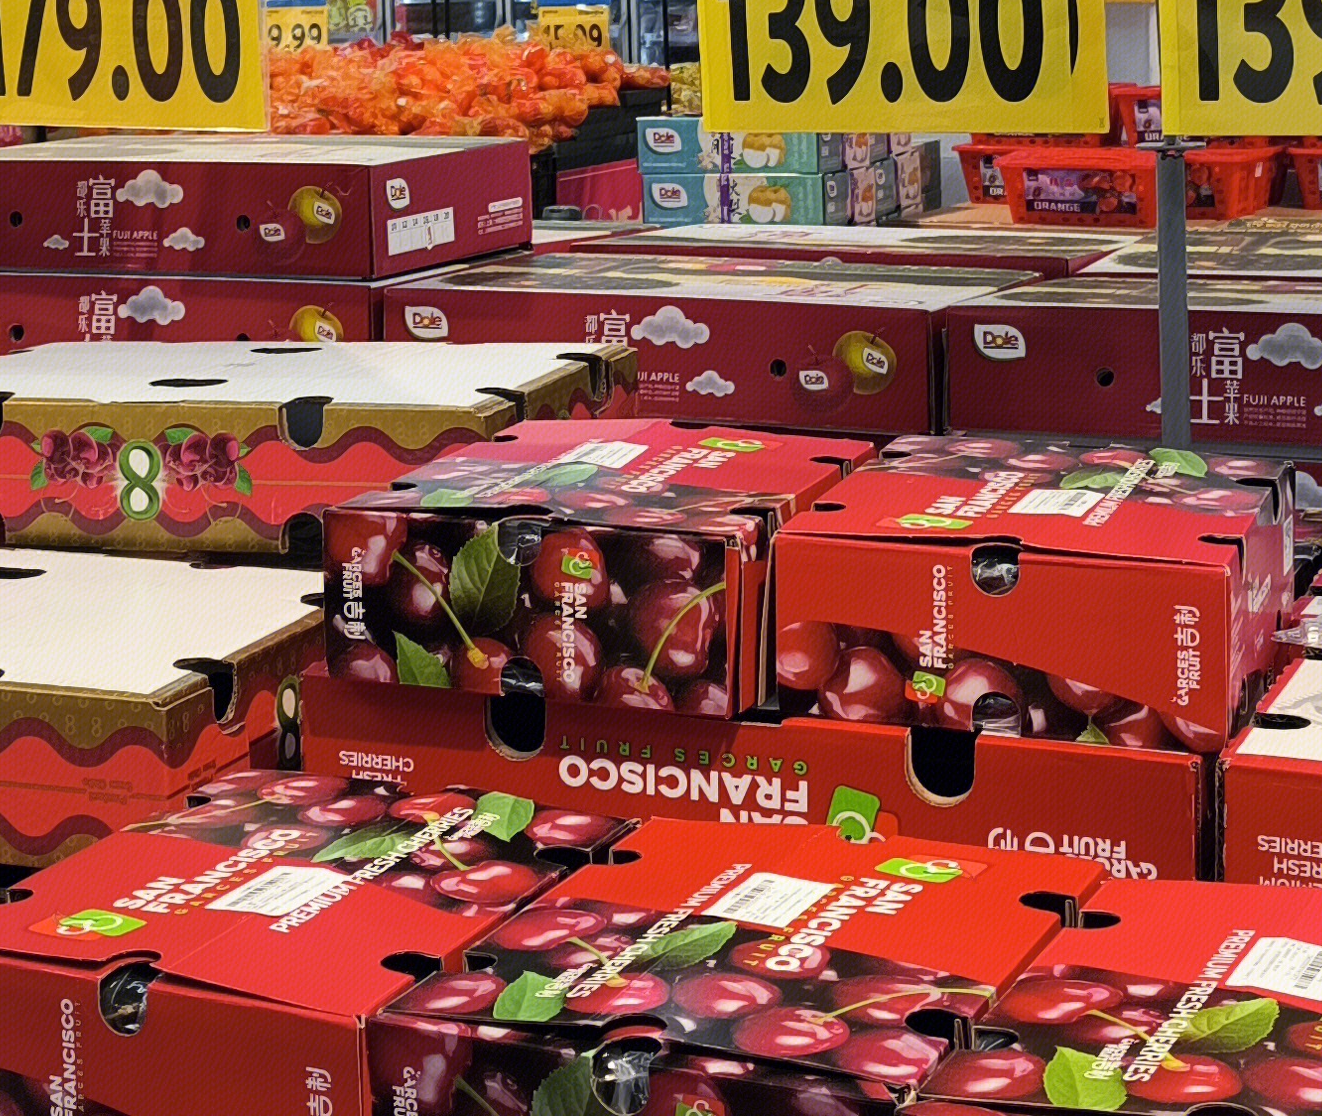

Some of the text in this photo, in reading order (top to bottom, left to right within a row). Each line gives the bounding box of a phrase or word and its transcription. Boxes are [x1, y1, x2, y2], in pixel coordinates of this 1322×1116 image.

[1034, 201, 1081, 212] ORANGE
[113, 230, 158, 241] FUJI APPLE
[411, 307, 445, 331] Dole
[982, 328, 1019, 348] Dole
[649, 371, 680, 383] APPLE
[1243, 394, 1307, 407] FUJI APPLE
[699, 451, 737, 469] SAN
[117, 441, 165, 522] 8
[955, 471, 1027, 518] FRANCISCO
[924, 495, 965, 515] SAN
[341, 562, 352, 598] FRUIT
[574, 583, 587, 619] SAN
[932, 564, 947, 669] FRANCISCO
[560, 581, 576, 683] FRANCISCO
[918, 629, 933, 669] SAN
[1174, 646, 1190, 706] GARCES
[1188, 644, 1202, 690] FRUIT
[338, 750, 414, 772] CHERRIES
[559, 735, 808, 775] GARCES FRUIT
[558, 755, 809, 813] FRANCISCO
[1058, 833, 1127, 860] FRUIT
[149, 828, 304, 915] FRANCISCO
[269, 805, 476, 934] PREMIUM FRESH CHERRIES
[686, 862, 752, 916] PREMIUM
[113, 875, 186, 912] SAN
[883, 883, 924, 915] SAN
[647, 906, 692, 949] FRESH
[767, 877, 873, 972] FRANCISCO
[566, 944, 652, 1000] CHERRIES
[1122, 929, 1256, 1083] PREMIUM FRESH CHERRIES
[62, 997, 75, 1116] FRANCISCO
